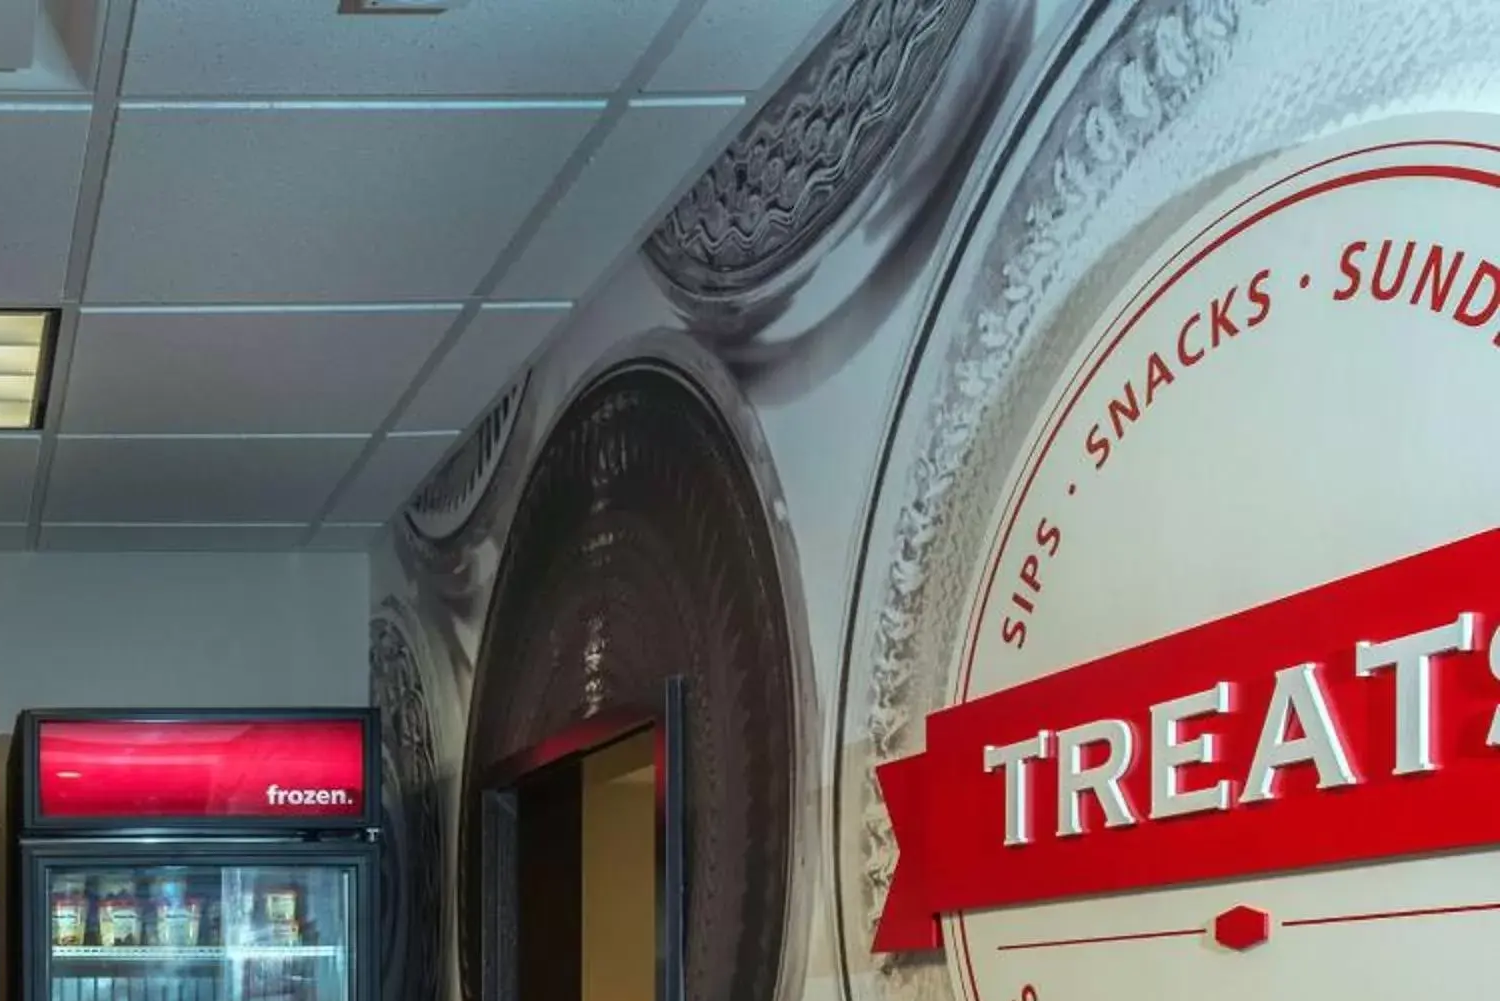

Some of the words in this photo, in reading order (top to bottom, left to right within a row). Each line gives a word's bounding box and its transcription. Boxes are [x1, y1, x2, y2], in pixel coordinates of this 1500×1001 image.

[1002, 517, 1060, 649] SIPS
[1085, 267, 1271, 469] SNACKS
[266, 784, 353, 805] frozen.
[983, 611, 1500, 846] TREAT
